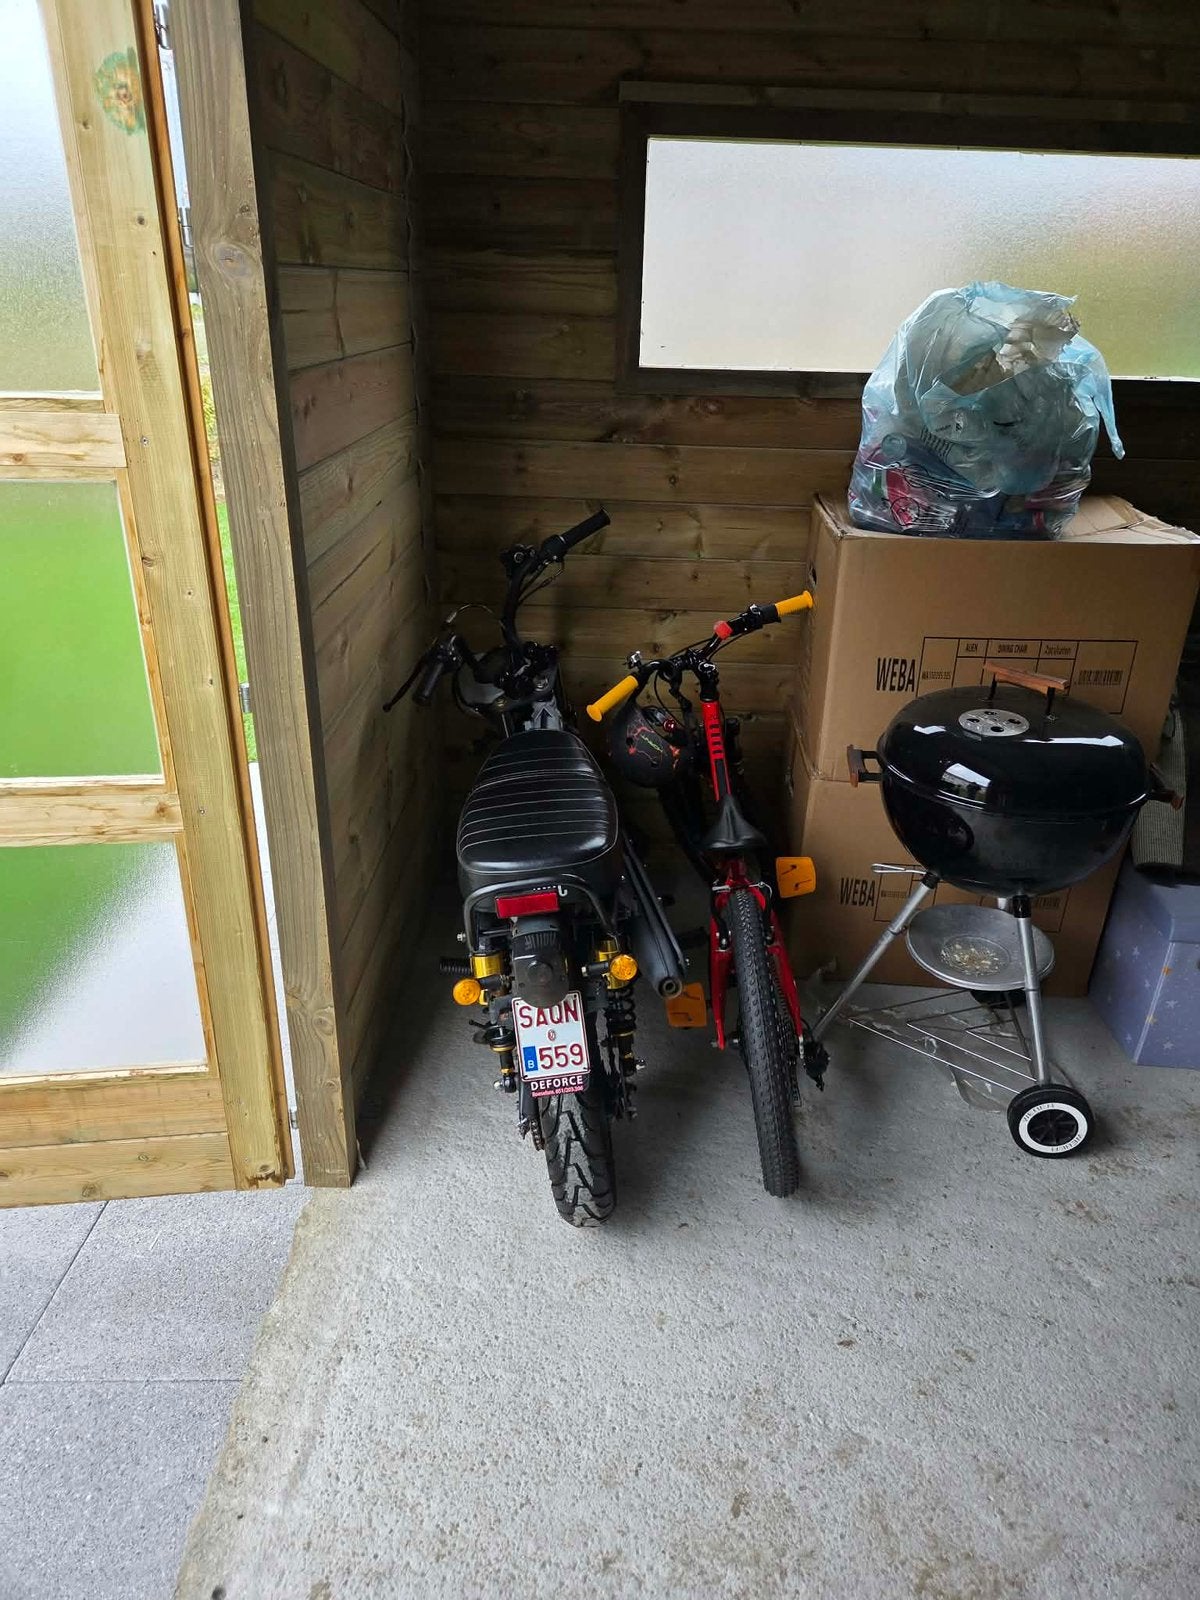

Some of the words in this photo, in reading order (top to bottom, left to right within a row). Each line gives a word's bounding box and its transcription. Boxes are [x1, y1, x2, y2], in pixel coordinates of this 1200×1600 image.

[875, 657, 916, 692] WEBA
[839, 877, 876, 907] WEBA
[527, 1059, 535, 1069] B
[538, 1043, 584, 1070] 559
[530, 1075, 584, 1091] DEFORCE
